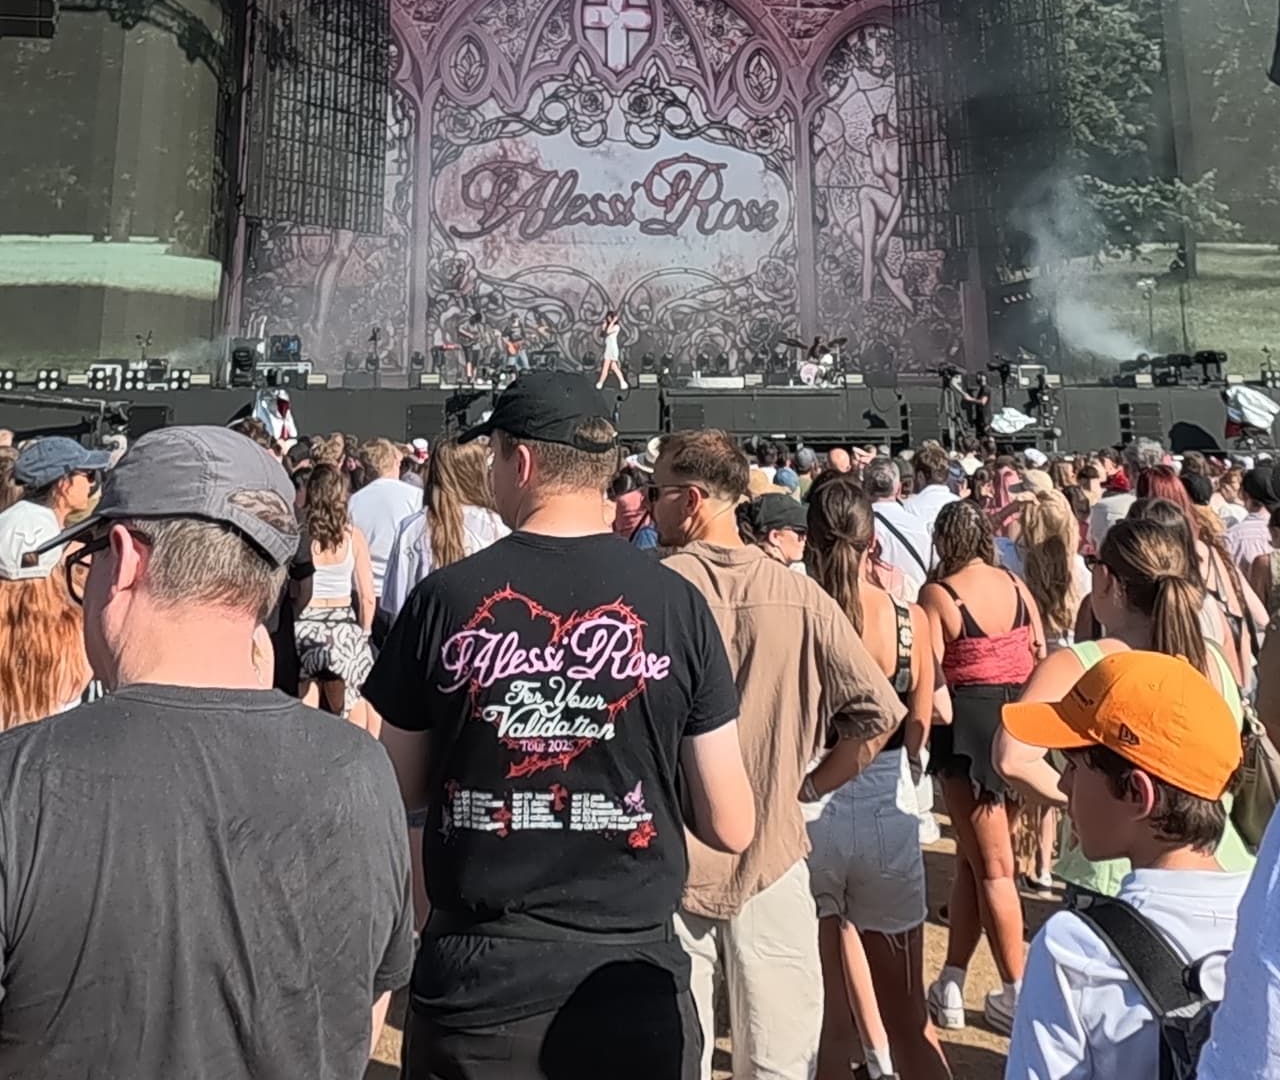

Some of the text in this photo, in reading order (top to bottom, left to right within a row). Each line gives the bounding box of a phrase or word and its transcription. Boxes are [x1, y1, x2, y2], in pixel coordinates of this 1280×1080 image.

[449, 153, 779, 239] Alessi Rose
[437, 616, 671, 693] Alessi Rose
[504, 676, 607, 717] For Your
[482, 704, 615, 740] Validation
[521, 740, 575, 752] Tour 2025
